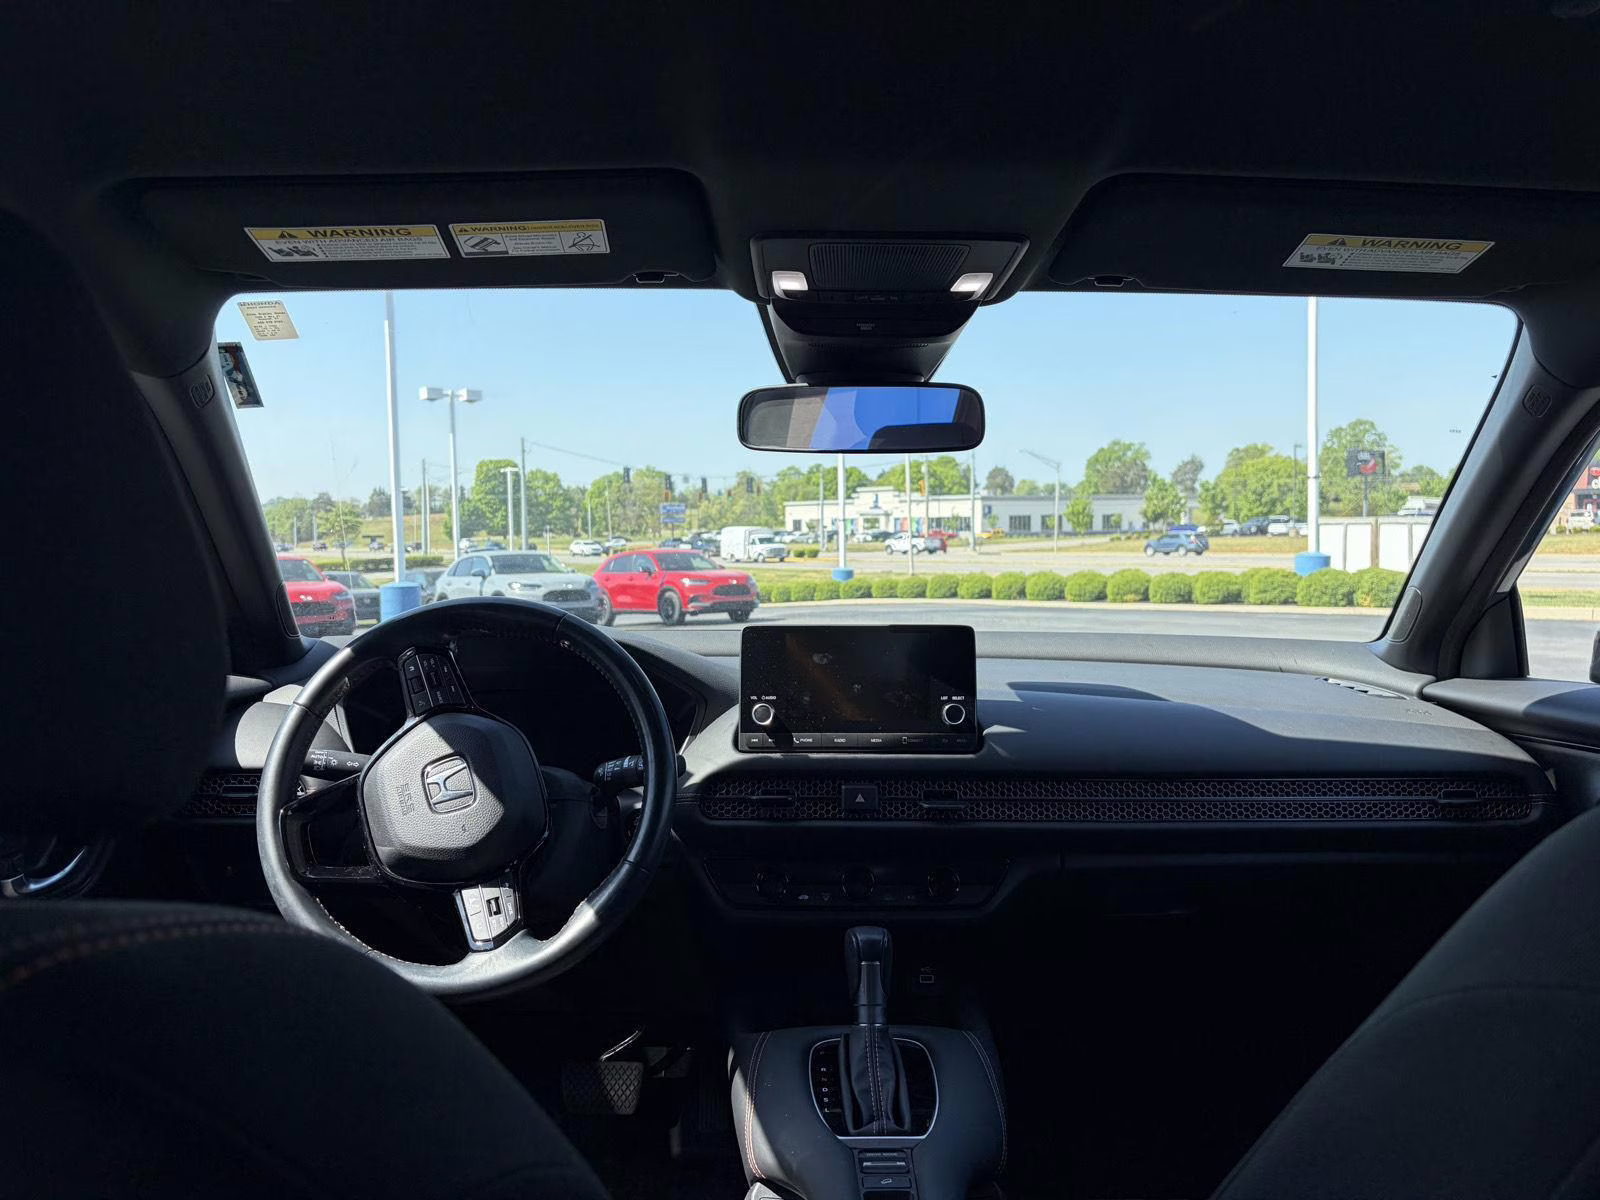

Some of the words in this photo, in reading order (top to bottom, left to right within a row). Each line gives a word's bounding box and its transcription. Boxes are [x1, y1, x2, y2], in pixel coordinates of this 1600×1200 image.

[307, 228, 412, 238] WARNING
[472, 225, 527, 233] WARNING
[1361, 239, 1462, 250] WARNING
